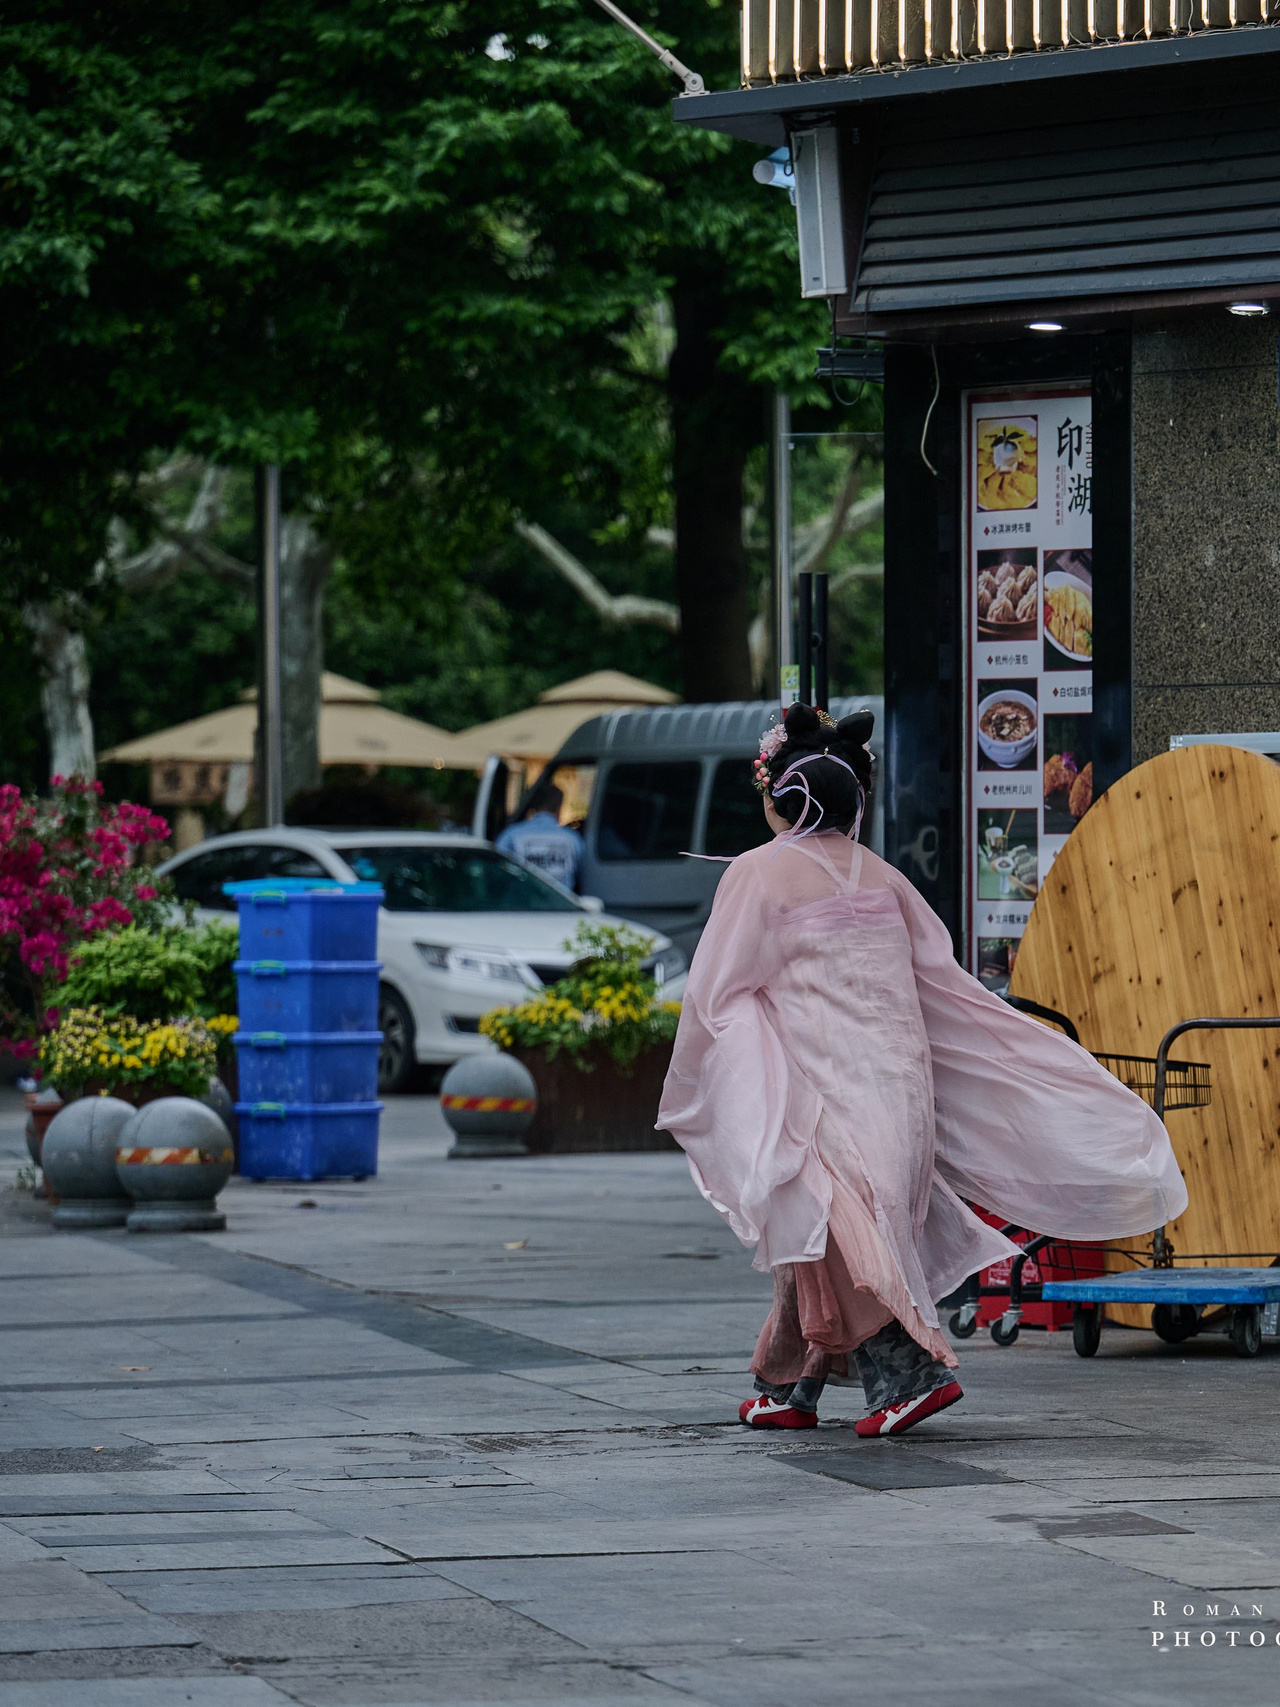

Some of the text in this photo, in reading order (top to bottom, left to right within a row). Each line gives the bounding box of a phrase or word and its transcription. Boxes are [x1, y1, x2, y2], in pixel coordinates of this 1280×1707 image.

[1057, 417, 1092, 516] 印湖
[995, 654, 1028, 665] 杭州小笼包
[992, 784, 1032, 796] 老杭州片儿川
